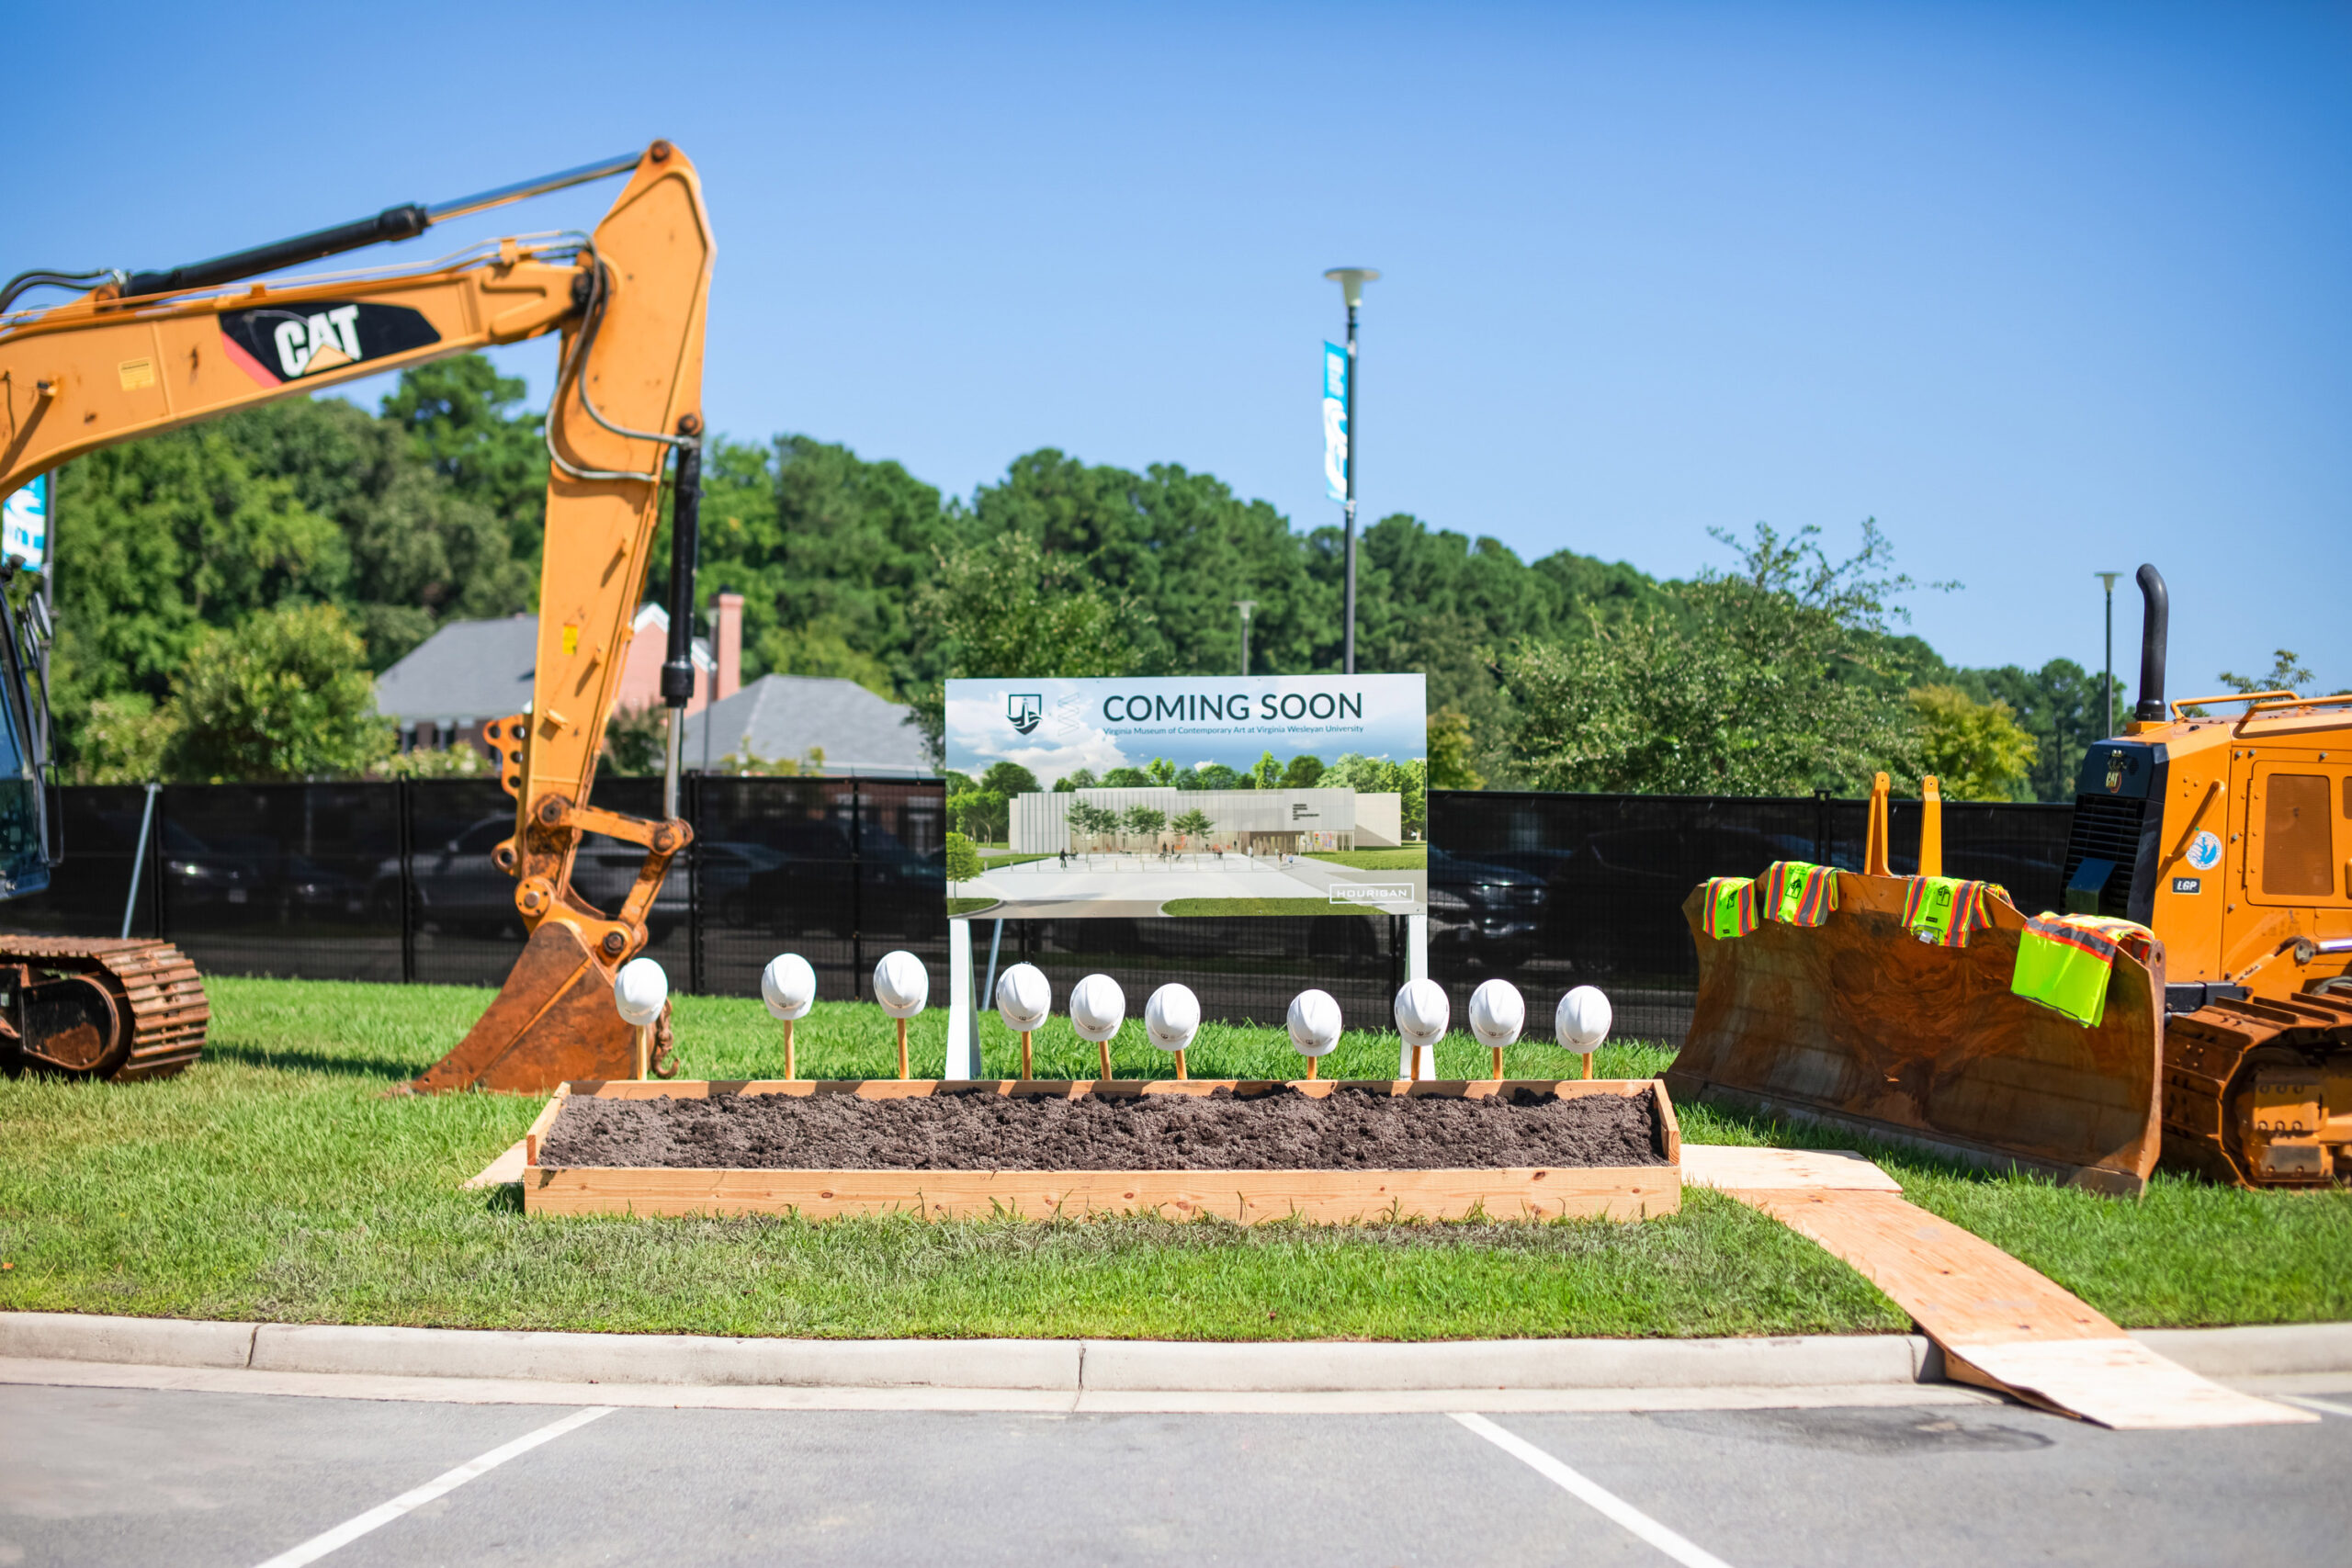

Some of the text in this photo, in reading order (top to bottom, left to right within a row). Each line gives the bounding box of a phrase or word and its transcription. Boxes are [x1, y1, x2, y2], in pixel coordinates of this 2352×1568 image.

[274, 304, 362, 378] CAT
[1102, 692, 1362, 722] COMING SOON
[1102, 728, 1132, 736] Virginia
[1134, 727, 1167, 735] Museum
[1168, 727, 1176, 735] of
[1177, 726, 1232, 736] Contemporary
[1233, 726, 1246, 734] Art
[1256, 725, 1285, 735] Virginia
[1286, 725, 1324, 734] Wesleyan
[1325, 725, 1363, 734] University
[1337, 889, 1408, 898] HOURIGAN
